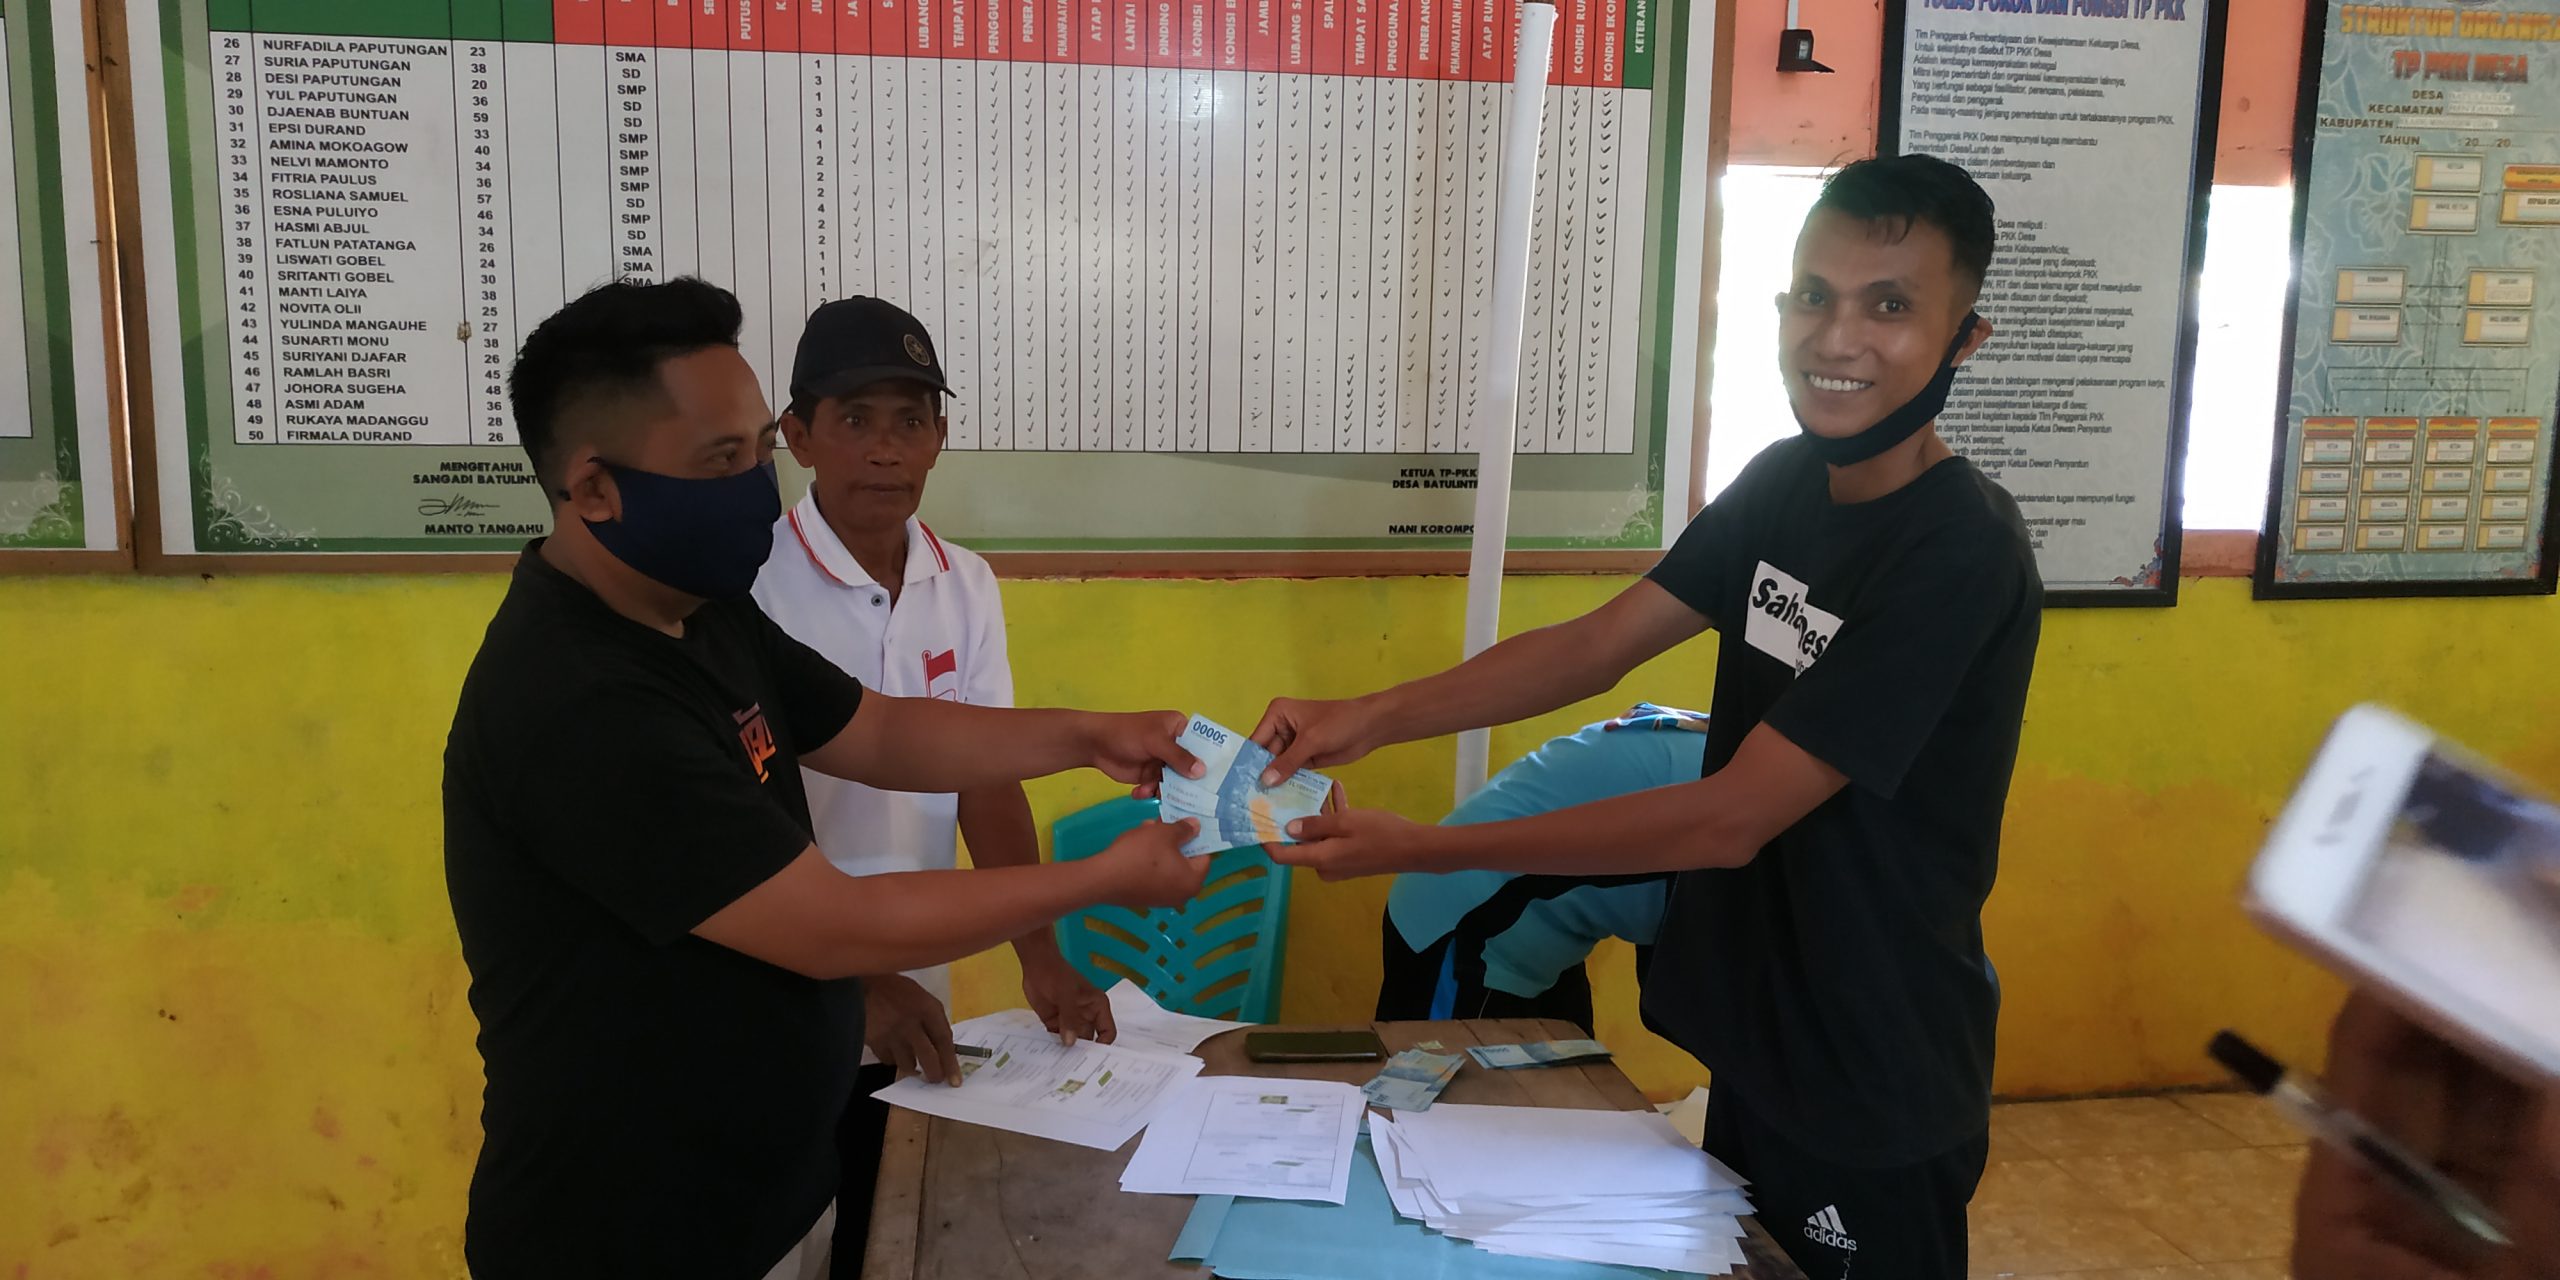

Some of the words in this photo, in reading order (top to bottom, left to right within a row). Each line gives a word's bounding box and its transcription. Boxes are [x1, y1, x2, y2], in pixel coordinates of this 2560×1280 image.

[1091, 7, 1102, 42] ATAP
[1125, 3, 1136, 51] LANTAI
[1159, 2, 1170, 56] DINDING
[1192, 4, 1203, 57] KONDISI
[1225, 12, 1236, 65] KONDISI
[1290, 14, 1302, 65] LUBANG
[1355, 18, 1366, 66] TEMPAT
[1482, 26, 1493, 60] ATAP
[223, 37, 240, 48] 26
[262, 39, 345, 52] NURFADILA
[348, 42, 447, 55] PAPUTUNGAN
[469, 46, 486, 56] 23
[616, 52, 646, 63] SMA
[1573, 24, 1585, 74] KONDISI
[1603, 31, 1615, 81] KONDISI
[224, 54, 240, 65] 27
[263, 56, 309, 67] SURIA
[312, 57, 410, 71] PAPUTUNGAN
[470, 63, 486, 73] 38
[622, 68, 641, 80] SD
[225, 71, 241, 82] 28
[264, 72, 298, 84] DESI
[302, 73, 400, 87] PAPUTUNGAN
[471, 79, 487, 89] 20
[617, 84, 647, 96] SMP
[226, 88, 242, 98] 29
[265, 89, 295, 100] YUL
[298, 90, 396, 103] PAPUTUNGAN
[472, 95, 488, 106] 36
[623, 100, 642, 112] SD
[2412, 90, 2444, 100] DESA
[228, 104, 243, 115] 30
[267, 106, 335, 118] DJAENAB
[339, 108, 409, 120] BUNTUAN
[473, 112, 488, 122] 59
[624, 116, 643, 128] SD
[2368, 104, 2444, 115] KECAMATAN
[2320, 117, 2393, 129] KABUPATEN
[229, 121, 243, 132] 31
[268, 122, 300, 133] EPSI
[304, 123, 365, 135] DURAND
[474, 128, 489, 139] 33
[619, 132, 648, 144] SMP
[2379, 135, 2420, 146] TAHUN
[230, 138, 245, 148] 32
[269, 139, 315, 150] AMINA
[319, 140, 408, 152] MOKOAGOW
[474, 145, 490, 155] 40
[619, 149, 649, 161] SMP
[270, 156, 310, 167] NELVI
[314, 157, 388, 169] MAMONTO
[271, 172, 316, 183] FITRIA
[319, 173, 376, 185] PAULUS
[272, 188, 346, 200] ROSLIANA
[349, 190, 408, 202] SAMUEL
[273, 205, 312, 216] ESNA
[315, 206, 378, 217] PULUIYO
[274, 221, 319, 232] HASMI
[323, 222, 369, 233] ABJUL
[275, 238, 329, 249] FATLUN
[333, 239, 416, 250] PATATANGA
[276, 254, 332, 265] LISWATI
[335, 255, 385, 266] GOBEL
[277, 270, 340, 281] SRITANTI
[344, 271, 393, 283] GOBEL
[278, 286, 322, 297] MANTI
[326, 287, 367, 297] LAIYA
[279, 302, 331, 313] NOVITA
[334, 303, 361, 314] OLII
[280, 318, 342, 329] YULINDA
[345, 319, 426, 330] MANGAUHE
[242, 334, 258, 344] 44
[281, 335, 343, 345] SUNARTI
[346, 335, 388, 346] MONU
[483, 338, 499, 348] 38
[242, 350, 259, 360] 45
[282, 351, 347, 361] SURIYANI
[351, 351, 406, 362] DJAFAR
[484, 354, 499, 364] 26
[244, 366, 260, 376] 46
[283, 366, 343, 377] RAMLAH
[347, 367, 390, 378] BASRI
[484, 369, 500, 379] 45
[245, 382, 260, 392] 47
[283, 383, 343, 393] JOHORA
[346, 383, 406, 394] SUGEHA
[485, 385, 501, 395] 48
[246, 398, 262, 408] 48
[284, 399, 319, 409] ASMI
[322, 399, 364, 409] ADAM
[486, 401, 501, 411] 36
[246, 414, 263, 424] 49
[285, 414, 343, 425] RUKAYA
[346, 415, 428, 425] MADANGGU
[487, 416, 502, 426] 28
[248, 430, 263, 440] 50
[286, 430, 349, 440] FIRMALA
[352, 431, 412, 441] DURAND
[487, 432, 503, 442] 26
[440, 461, 523, 472] MENGETAHUI
[1400, 468, 1435, 478] KETUA
[1440, 468, 1478, 478] TP-PKK
[413, 474, 473, 484] SANGADI
[477, 475, 540, 485] BATULINT
[1392, 480, 1420, 489] DESA
[424, 524, 474, 534] MANTO
[479, 524, 544, 534] TANGAHU
[1389, 525, 1417, 534] NANI
[1192, 720, 1228, 745] 50000
[1803, 1226, 1857, 1251] adidas
